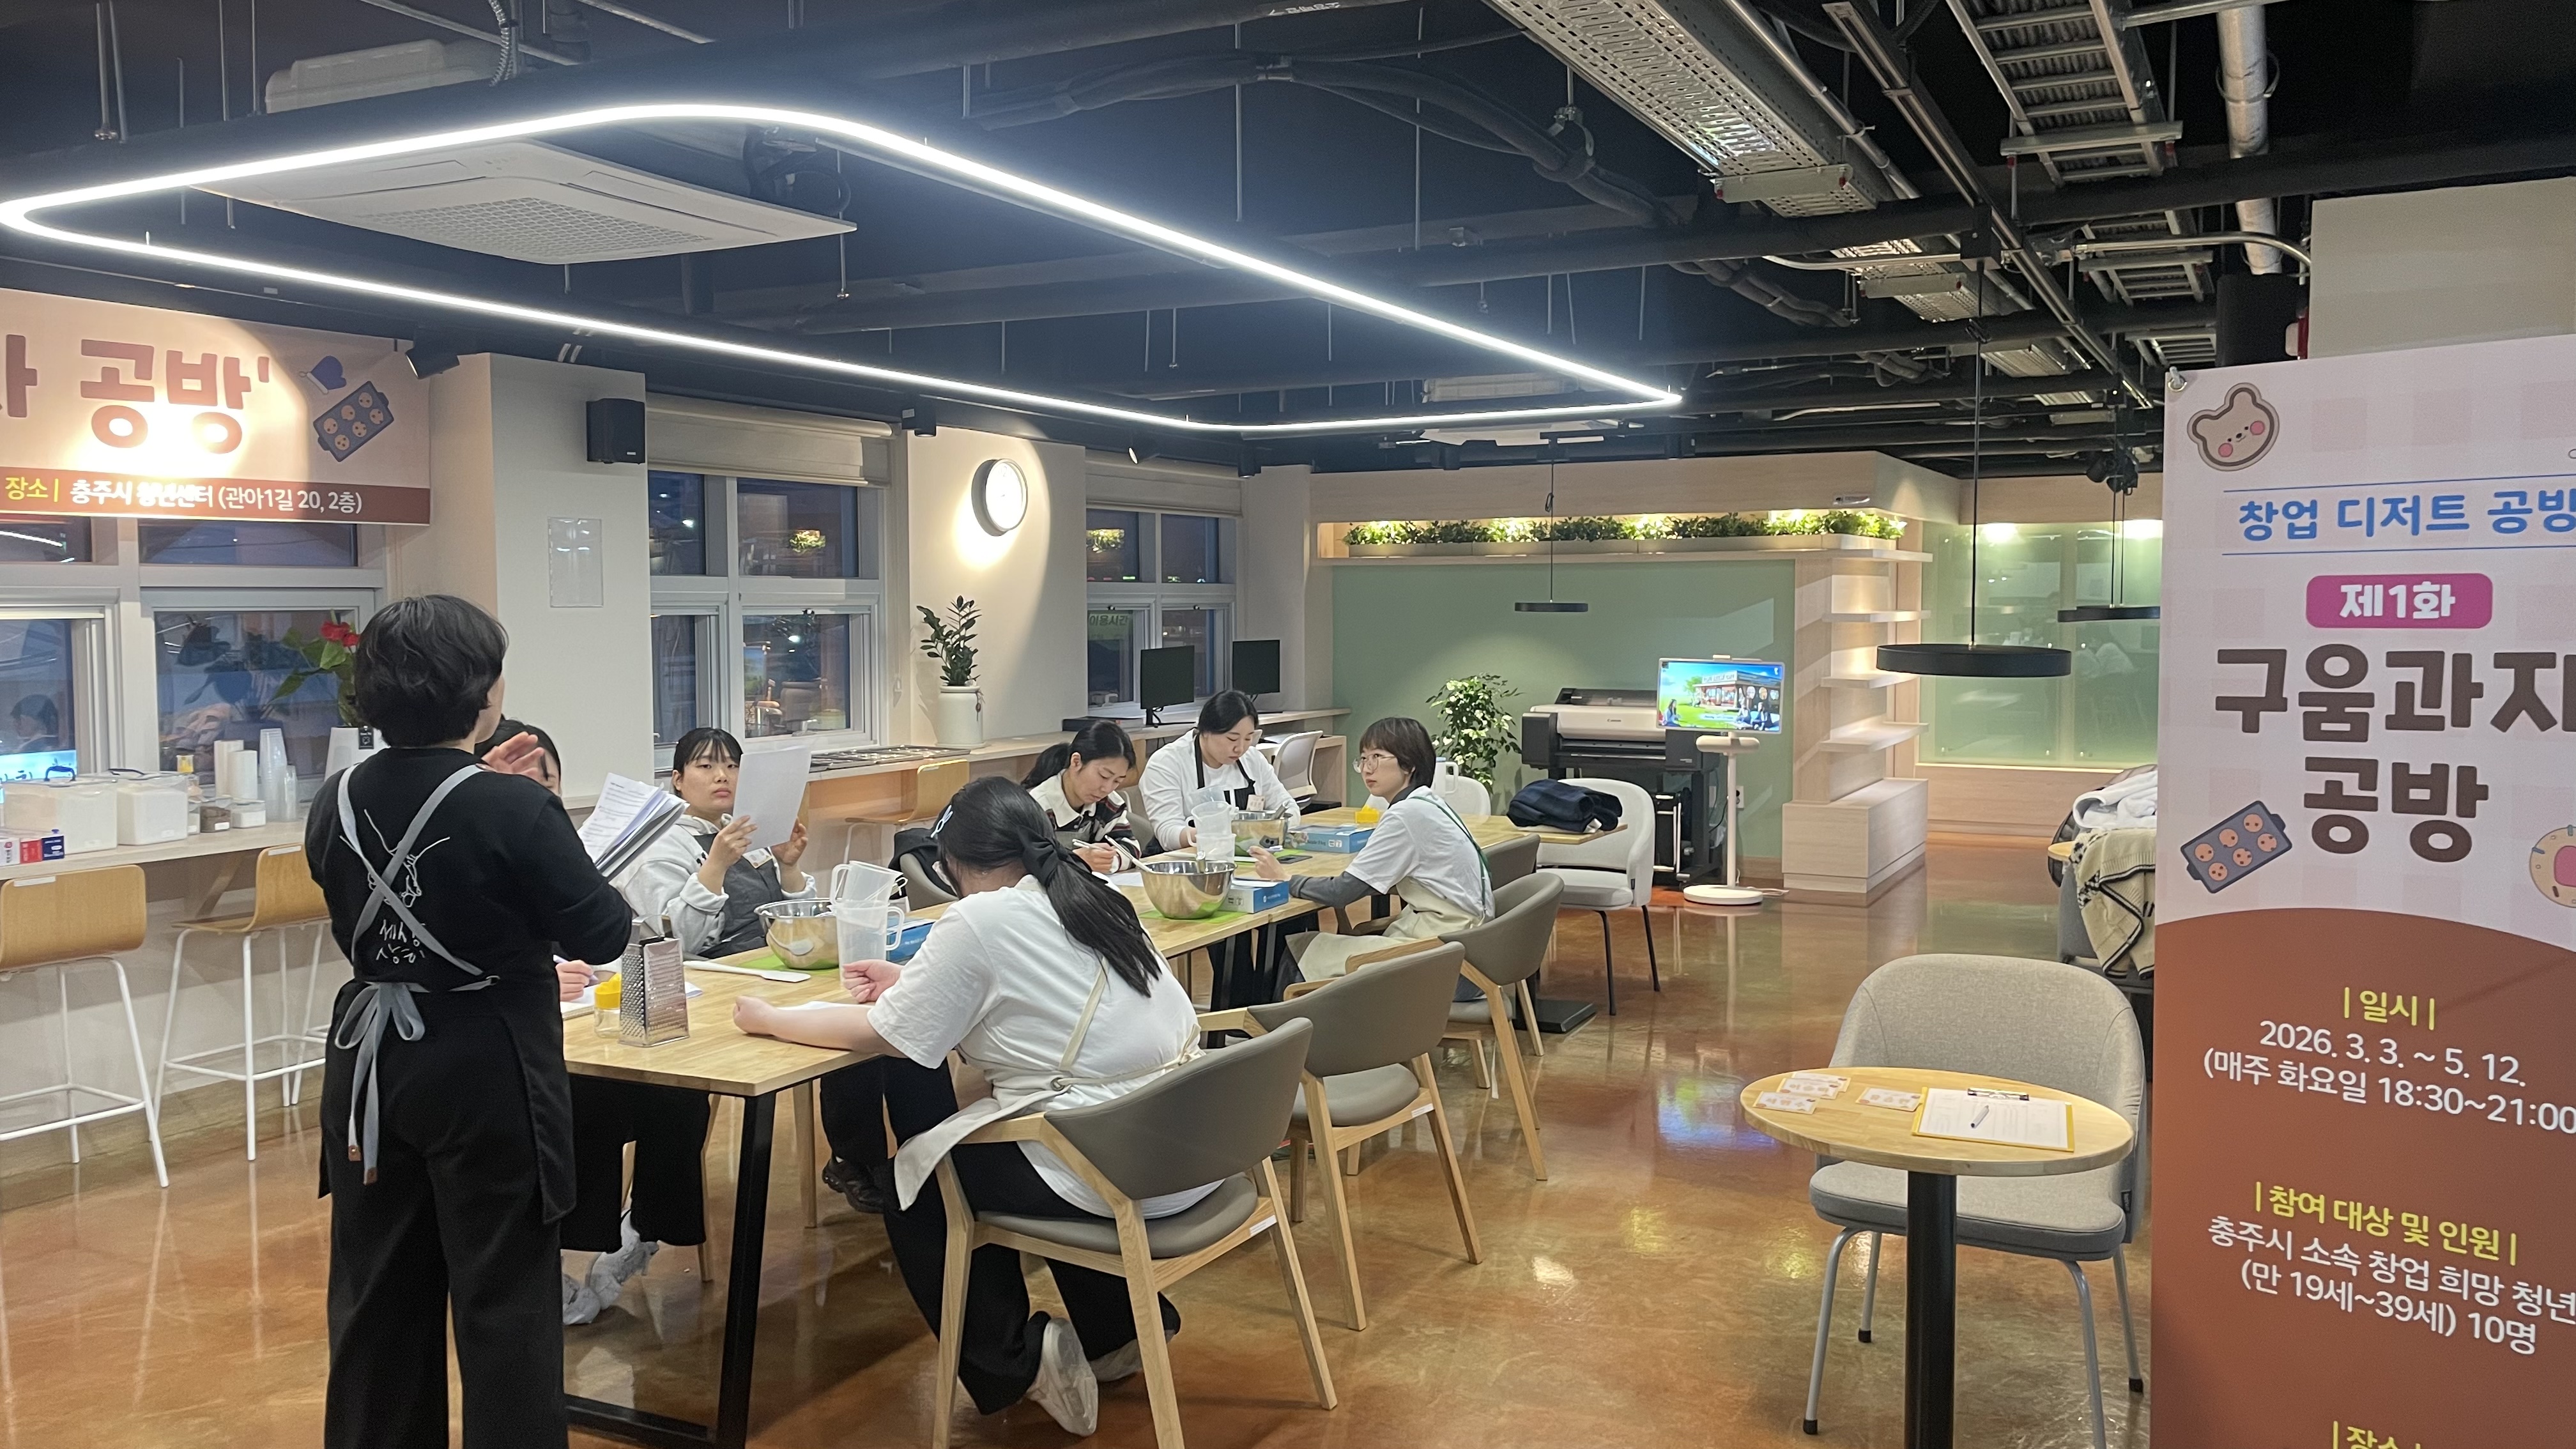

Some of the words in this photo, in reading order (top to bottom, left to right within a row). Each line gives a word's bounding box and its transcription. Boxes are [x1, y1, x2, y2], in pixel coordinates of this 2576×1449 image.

[5, 477, 49, 500] 장소
[70, 479, 133, 505] 충주시
[218, 486, 294, 512] (관아1길
[297, 490, 325, 513] 20,
[328, 491, 362, 514] 2층)
[2239, 500, 2318, 542] 창업
[2337, 494, 2470, 537] 디저트
[2487, 488, 2576, 534] 공방
[2339, 581, 2456, 620] 제1화
[2303, 756, 2489, 863] 공방
[2359, 990, 2418, 1026] 일시
[2204, 1047, 2272, 1085] (매주
[2278, 1060, 2366, 1104] 화요일
[2260, 1020, 2338, 1058] 2026.
[2345, 1033, 2370, 1063] 3.
[2379, 1038, 2404, 1068] 3.
[2444, 1048, 2470, 1078] 5.
[2481, 1054, 2526, 1087] 12.
[2269, 1185, 2325, 1224] 참여
[2333, 1200, 2394, 1237] 대상
[2401, 1212, 2430, 1247] 및
[2439, 1222, 2499, 1261] 인원
[2208, 1216, 2292, 1261] 충주시
[2301, 1238, 2362, 1276] 소속
[2368, 1250, 2430, 1292] 창업
[2438, 1266, 2505, 1307] 희망
[2512, 1281, 2576, 1325] 청년
[2241, 1259, 2283, 1295] (만
[2290, 1271, 2457, 1337] 19세~39세)
[2468, 1312, 2536, 1354] 10명
